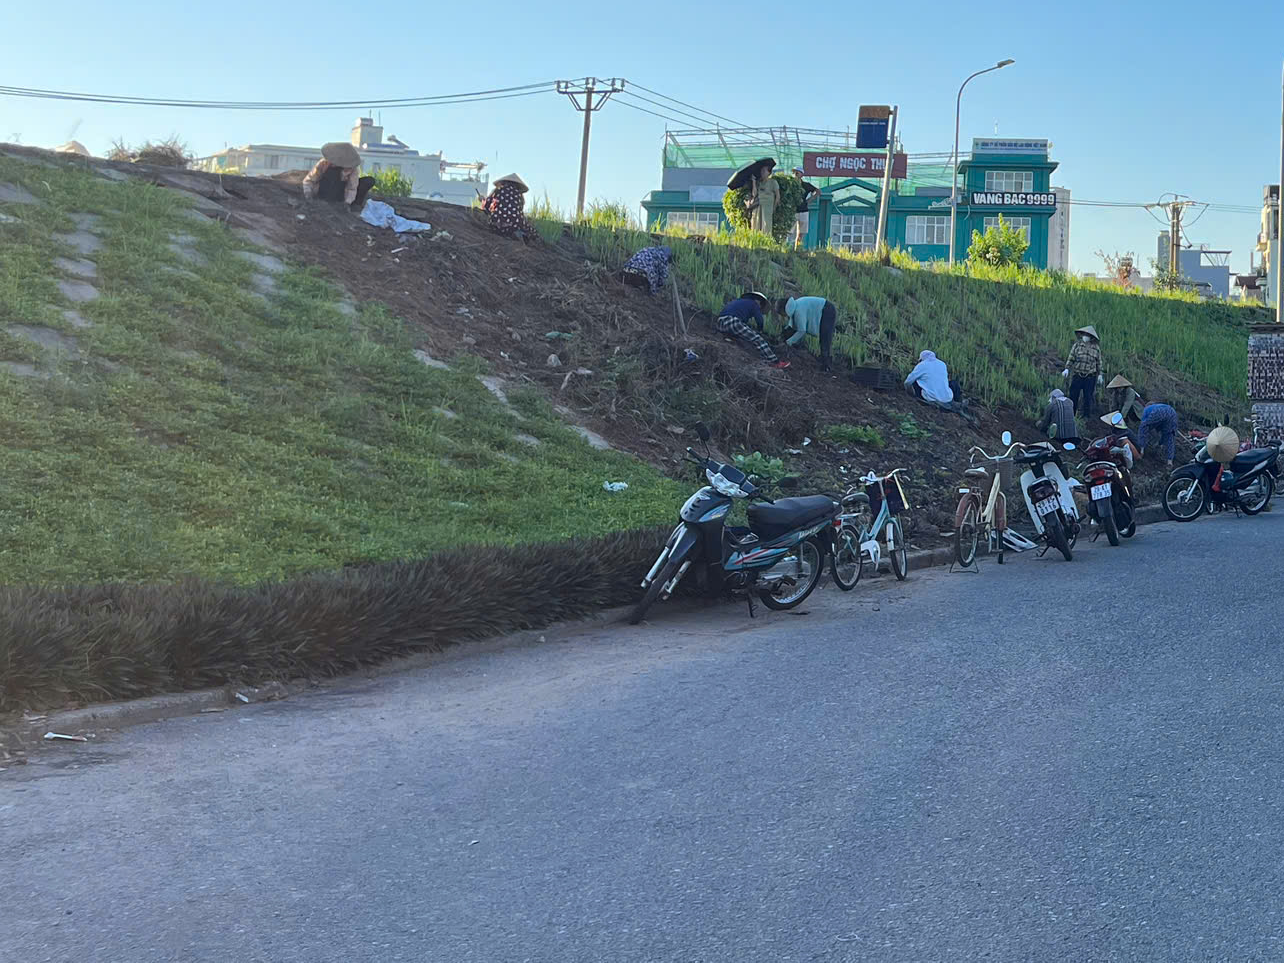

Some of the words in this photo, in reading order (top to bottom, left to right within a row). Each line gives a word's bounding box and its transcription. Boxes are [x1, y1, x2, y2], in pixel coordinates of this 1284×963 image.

[816, 156, 837, 171] CHỢ
[840, 157, 867, 172] NGỌC
[871, 158, 895, 172] TH
[1026, 193, 1055, 205] 9999
